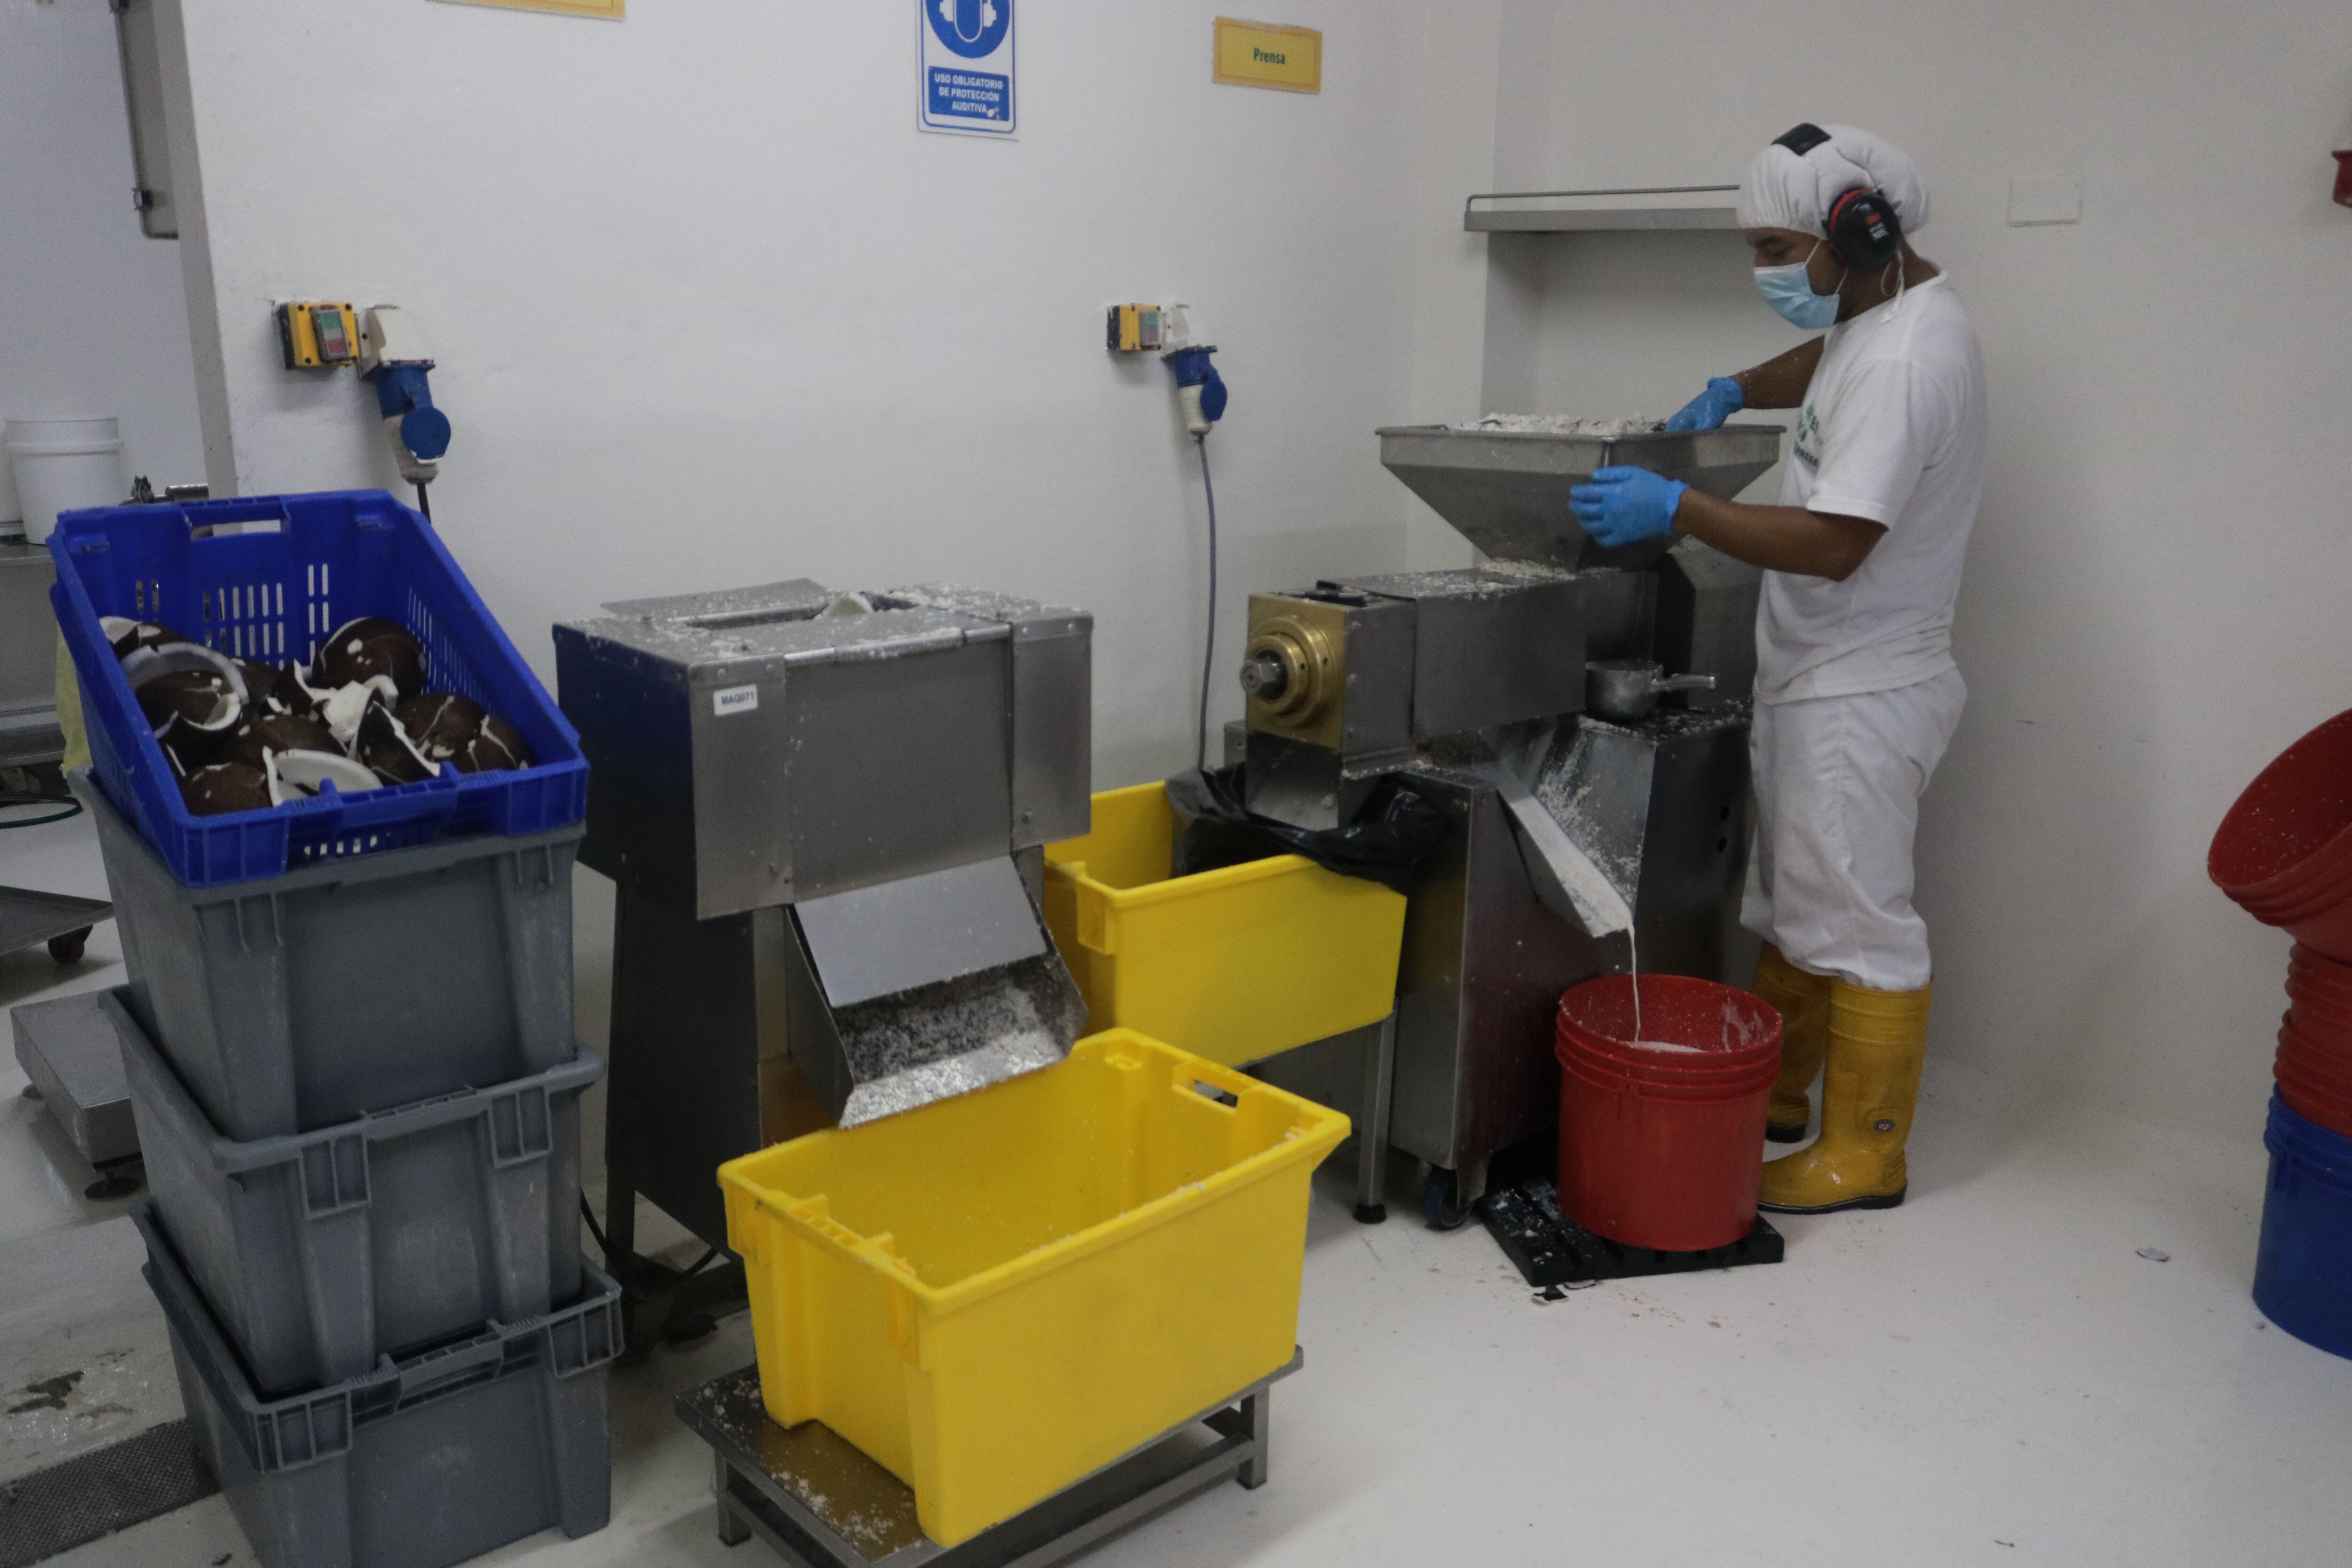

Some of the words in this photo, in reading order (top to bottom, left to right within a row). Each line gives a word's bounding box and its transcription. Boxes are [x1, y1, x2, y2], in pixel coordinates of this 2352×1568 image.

[1254, 48, 1285, 64] Prensa
[935, 73, 951, 83] USO
[953, 75, 1003, 89] OBLIGATORIO
[939, 87, 949, 96] DE
[952, 101, 987, 113] AUDITIVA
